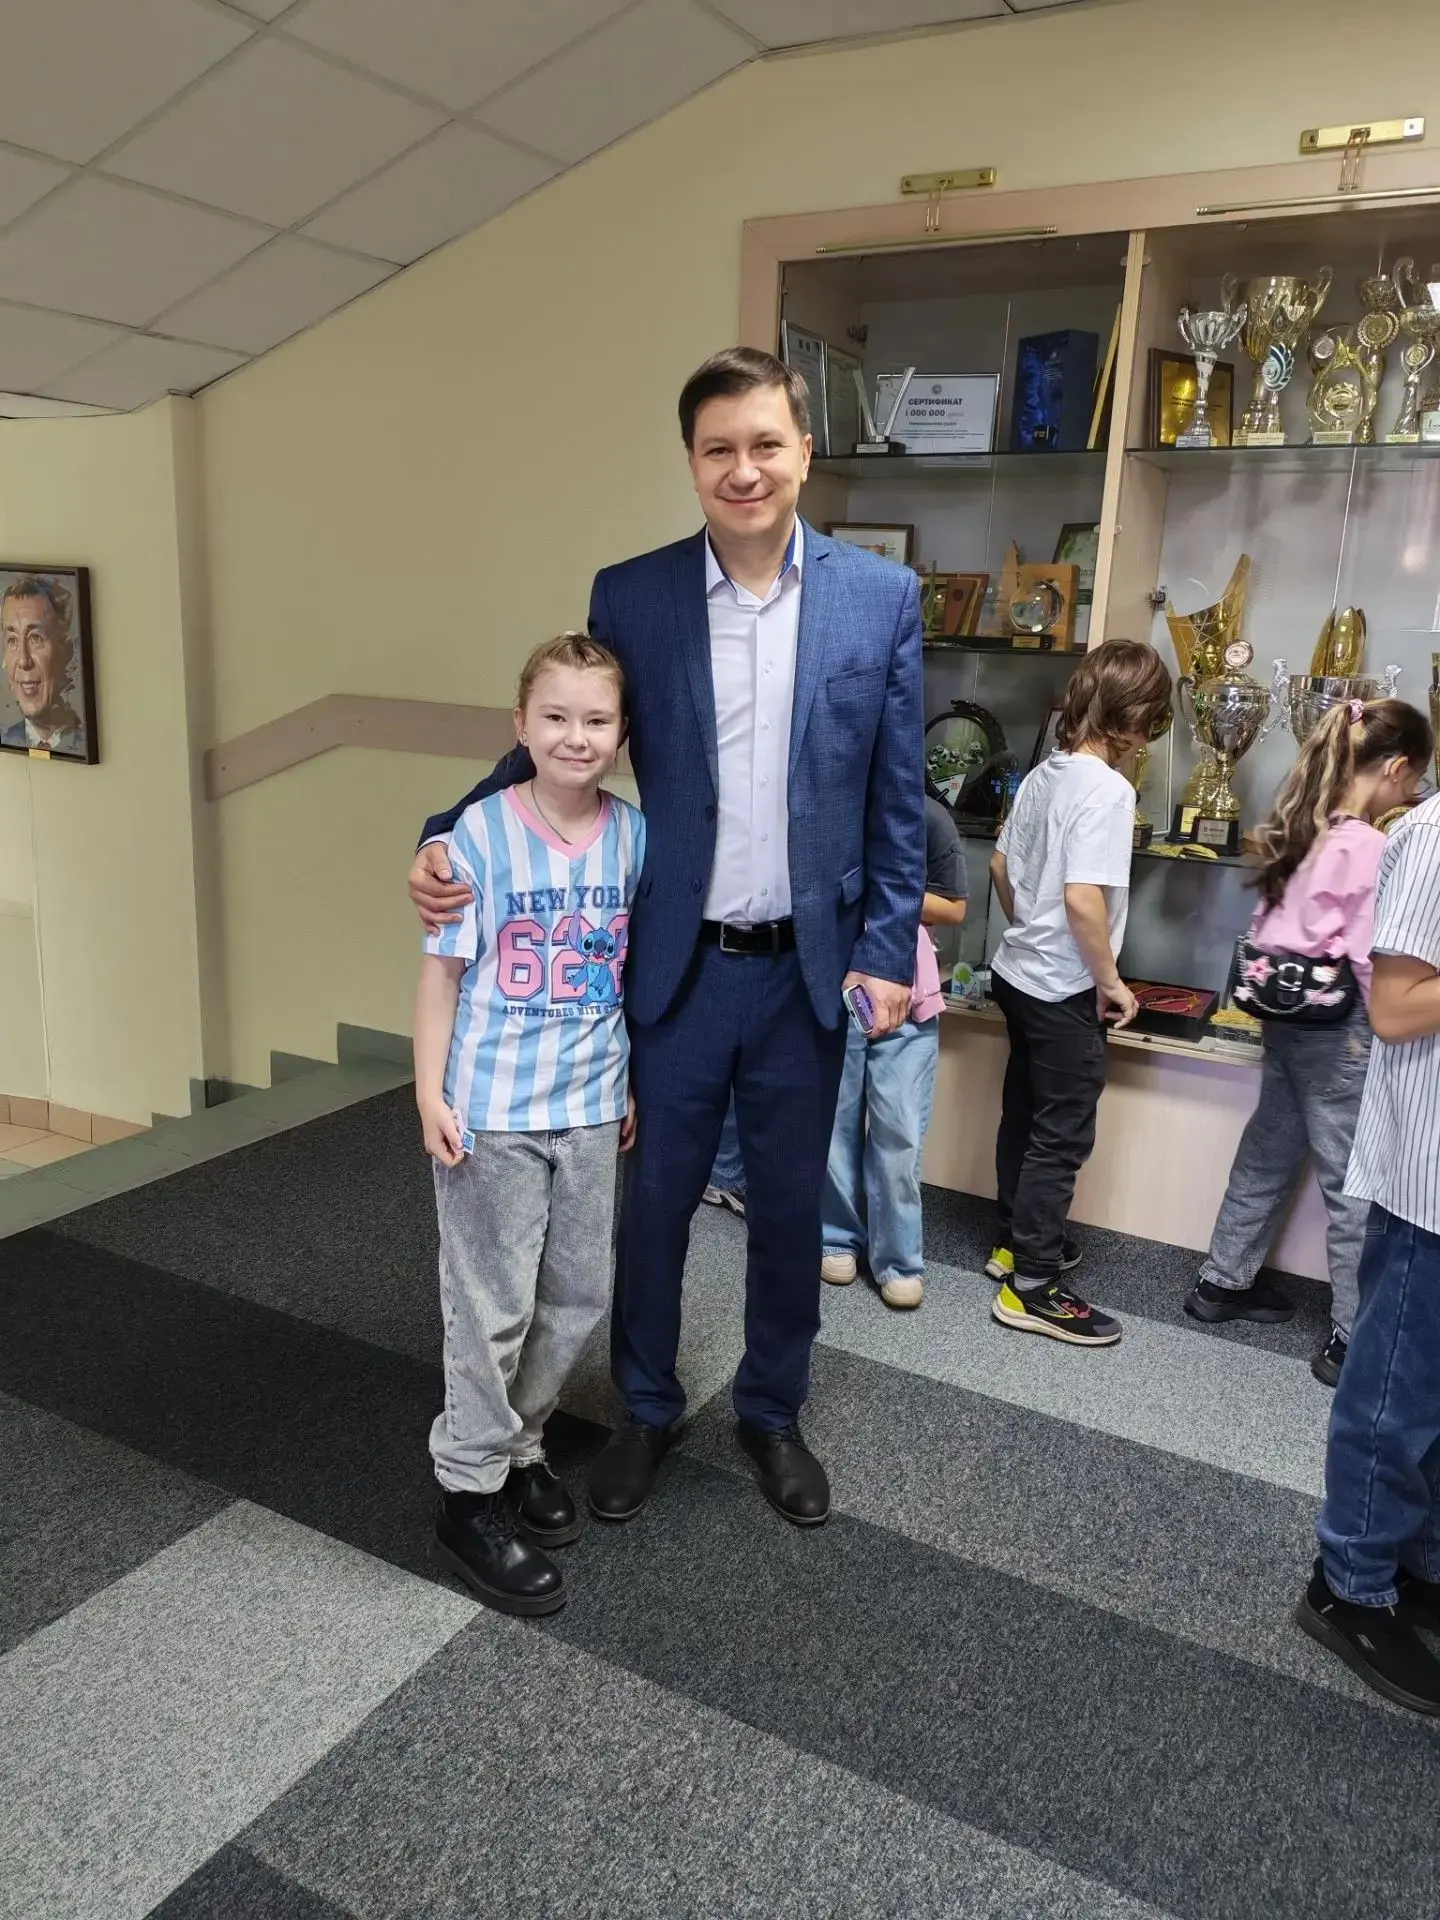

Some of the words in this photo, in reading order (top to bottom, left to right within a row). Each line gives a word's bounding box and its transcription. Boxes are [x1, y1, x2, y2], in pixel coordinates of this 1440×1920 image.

[908, 398, 963, 406] СЕРТИФИКАТ
[910, 409, 927, 417] 000
[929, 409, 945, 417] 000
[505, 888, 566, 916] NEW
[574, 885, 629, 909] YOR
[502, 1005, 574, 1018] ADVENTURES
[576, 1005, 602, 1017] WITH
